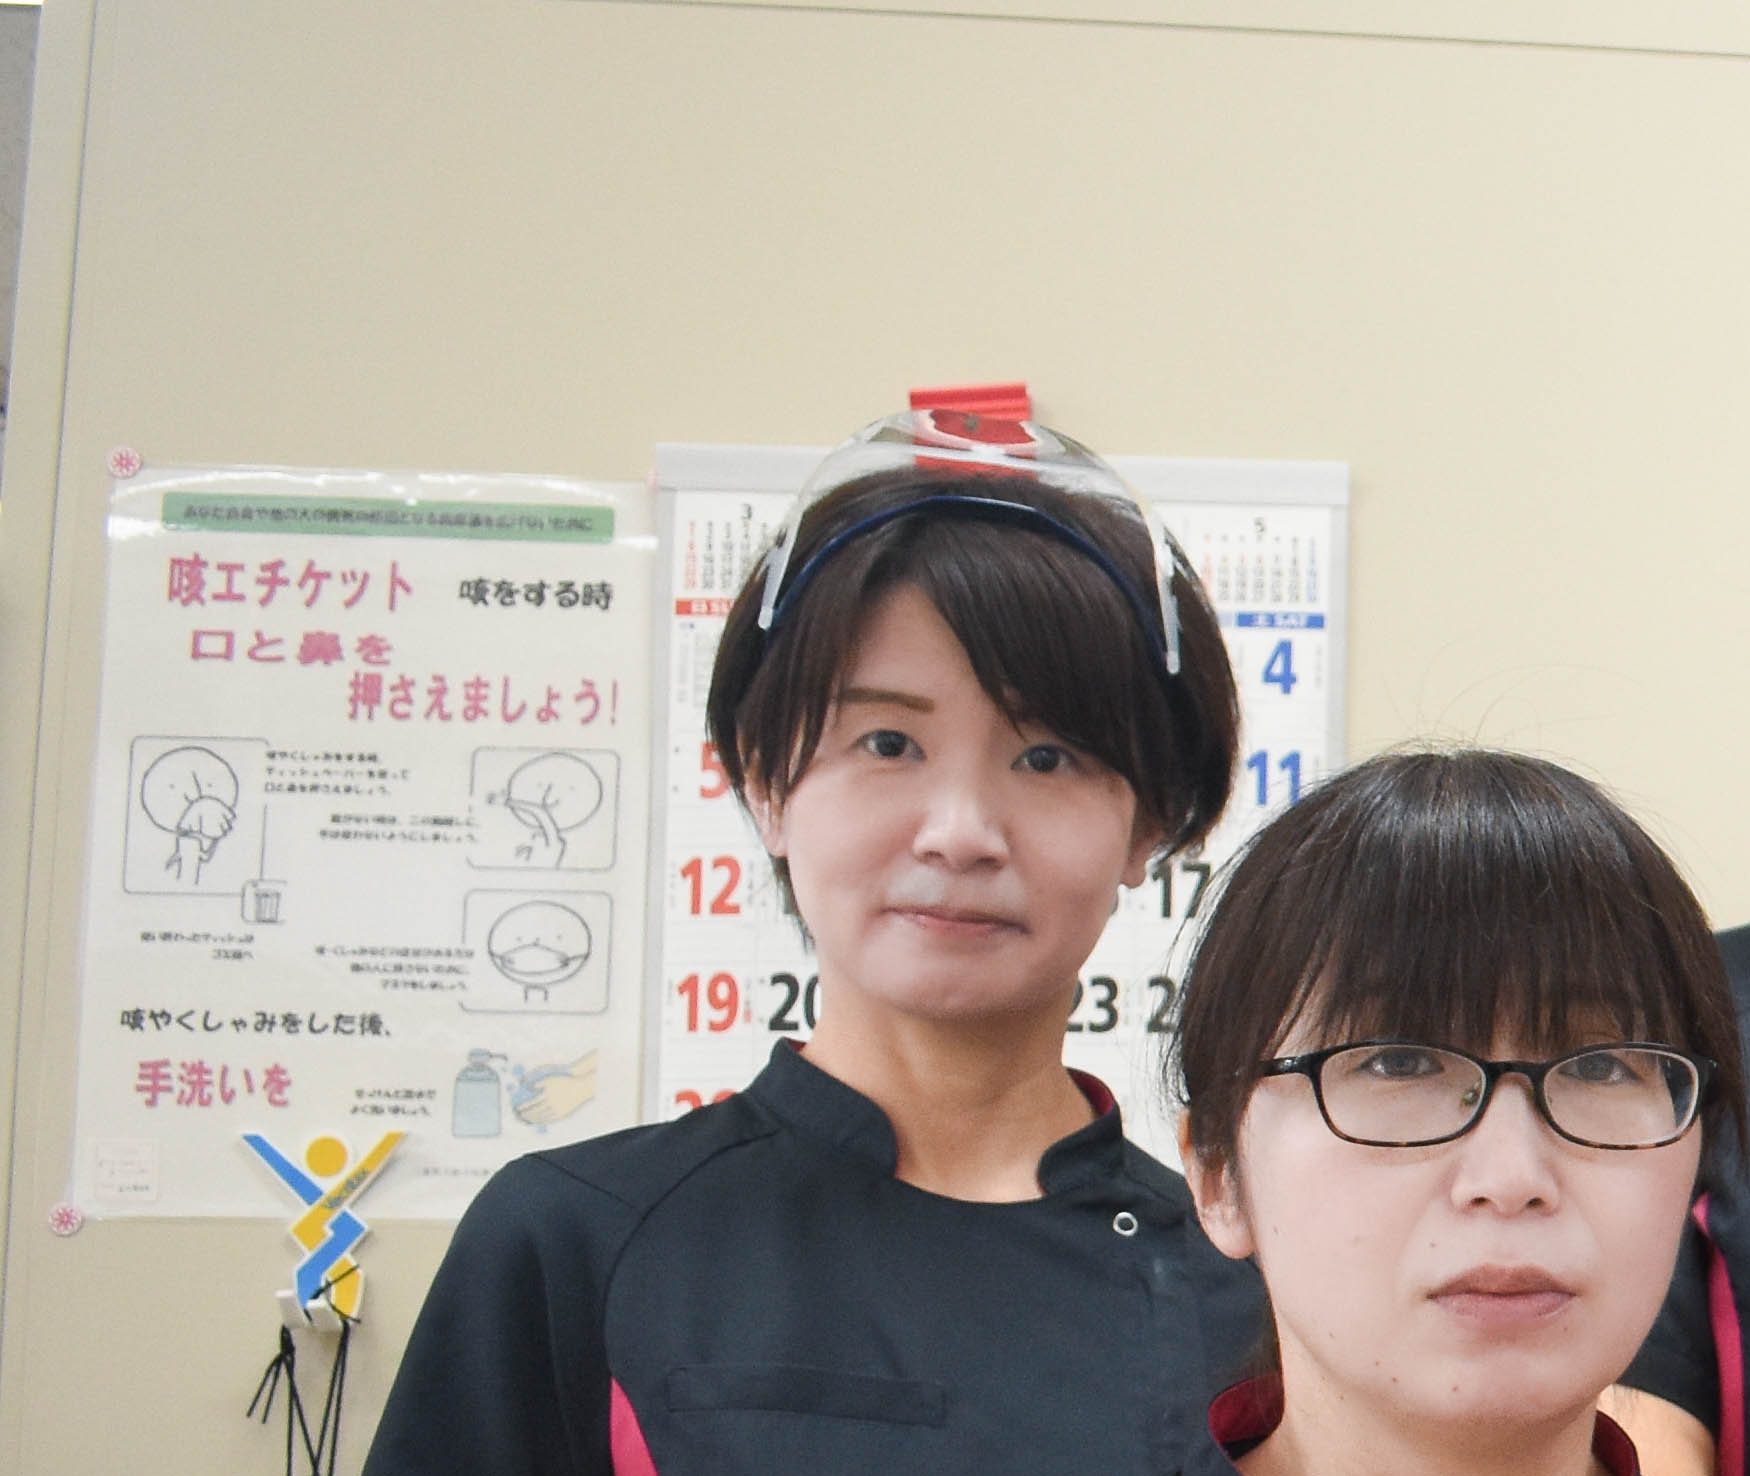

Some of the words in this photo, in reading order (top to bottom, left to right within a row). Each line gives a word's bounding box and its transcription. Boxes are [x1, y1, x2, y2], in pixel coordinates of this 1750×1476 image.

[168, 553, 412, 610] 咳エチケット
[459, 577, 614, 612] 咳をする時
[190, 630, 393, 666] 口と鼻を
[1263, 640, 1297, 695] 4
[698, 741, 728, 799] 5
[1246, 751, 1301, 807] 11
[680, 855, 742, 916] 12
[1152, 862, 1211, 918] 17
[120, 1009, 393, 1037] 咳やくしゃみをした後、
[677, 971, 740, 1033] 19
[1146, 975, 1179, 1033] 2
[134, 1059, 292, 1107] 手洗いを
